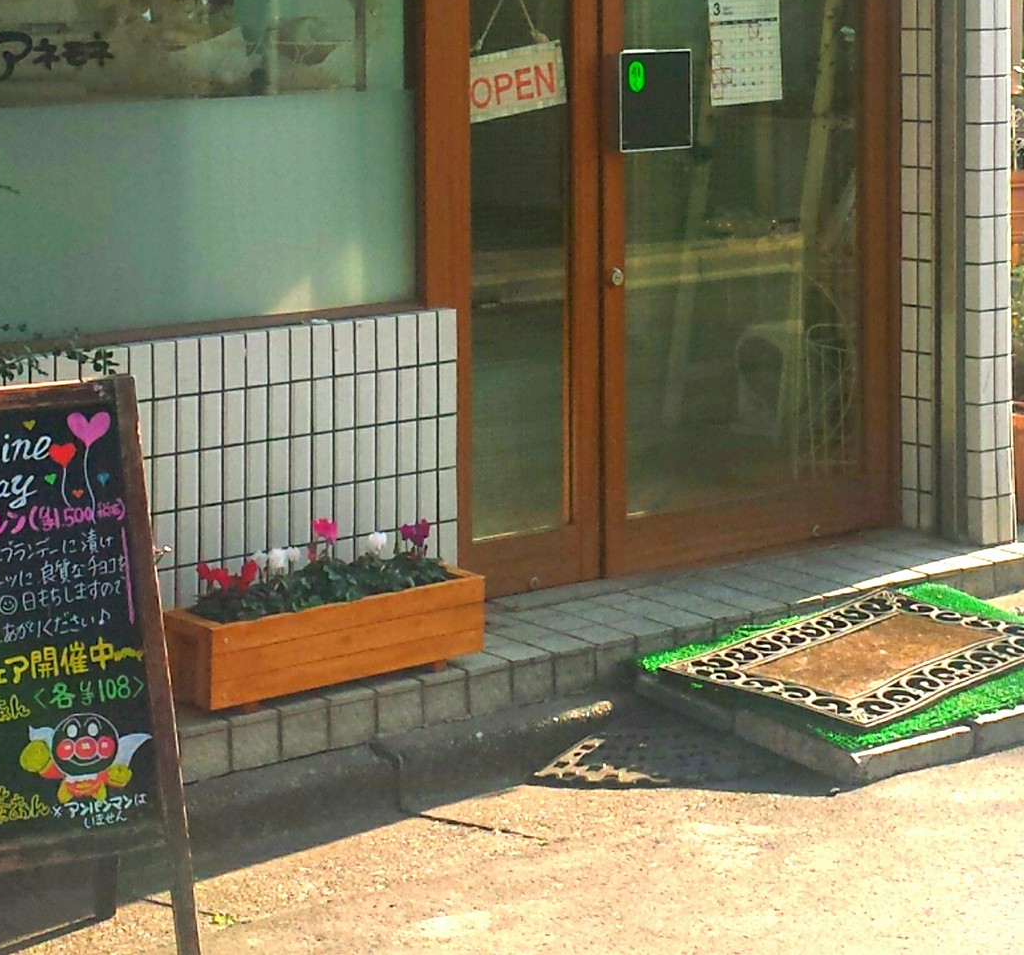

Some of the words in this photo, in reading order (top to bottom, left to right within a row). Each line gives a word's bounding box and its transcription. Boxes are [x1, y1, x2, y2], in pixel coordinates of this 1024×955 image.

[712, 2, 722, 17] 3
[469, 62, 557, 109] OPEN
[83, 809, 127, 829] いません
